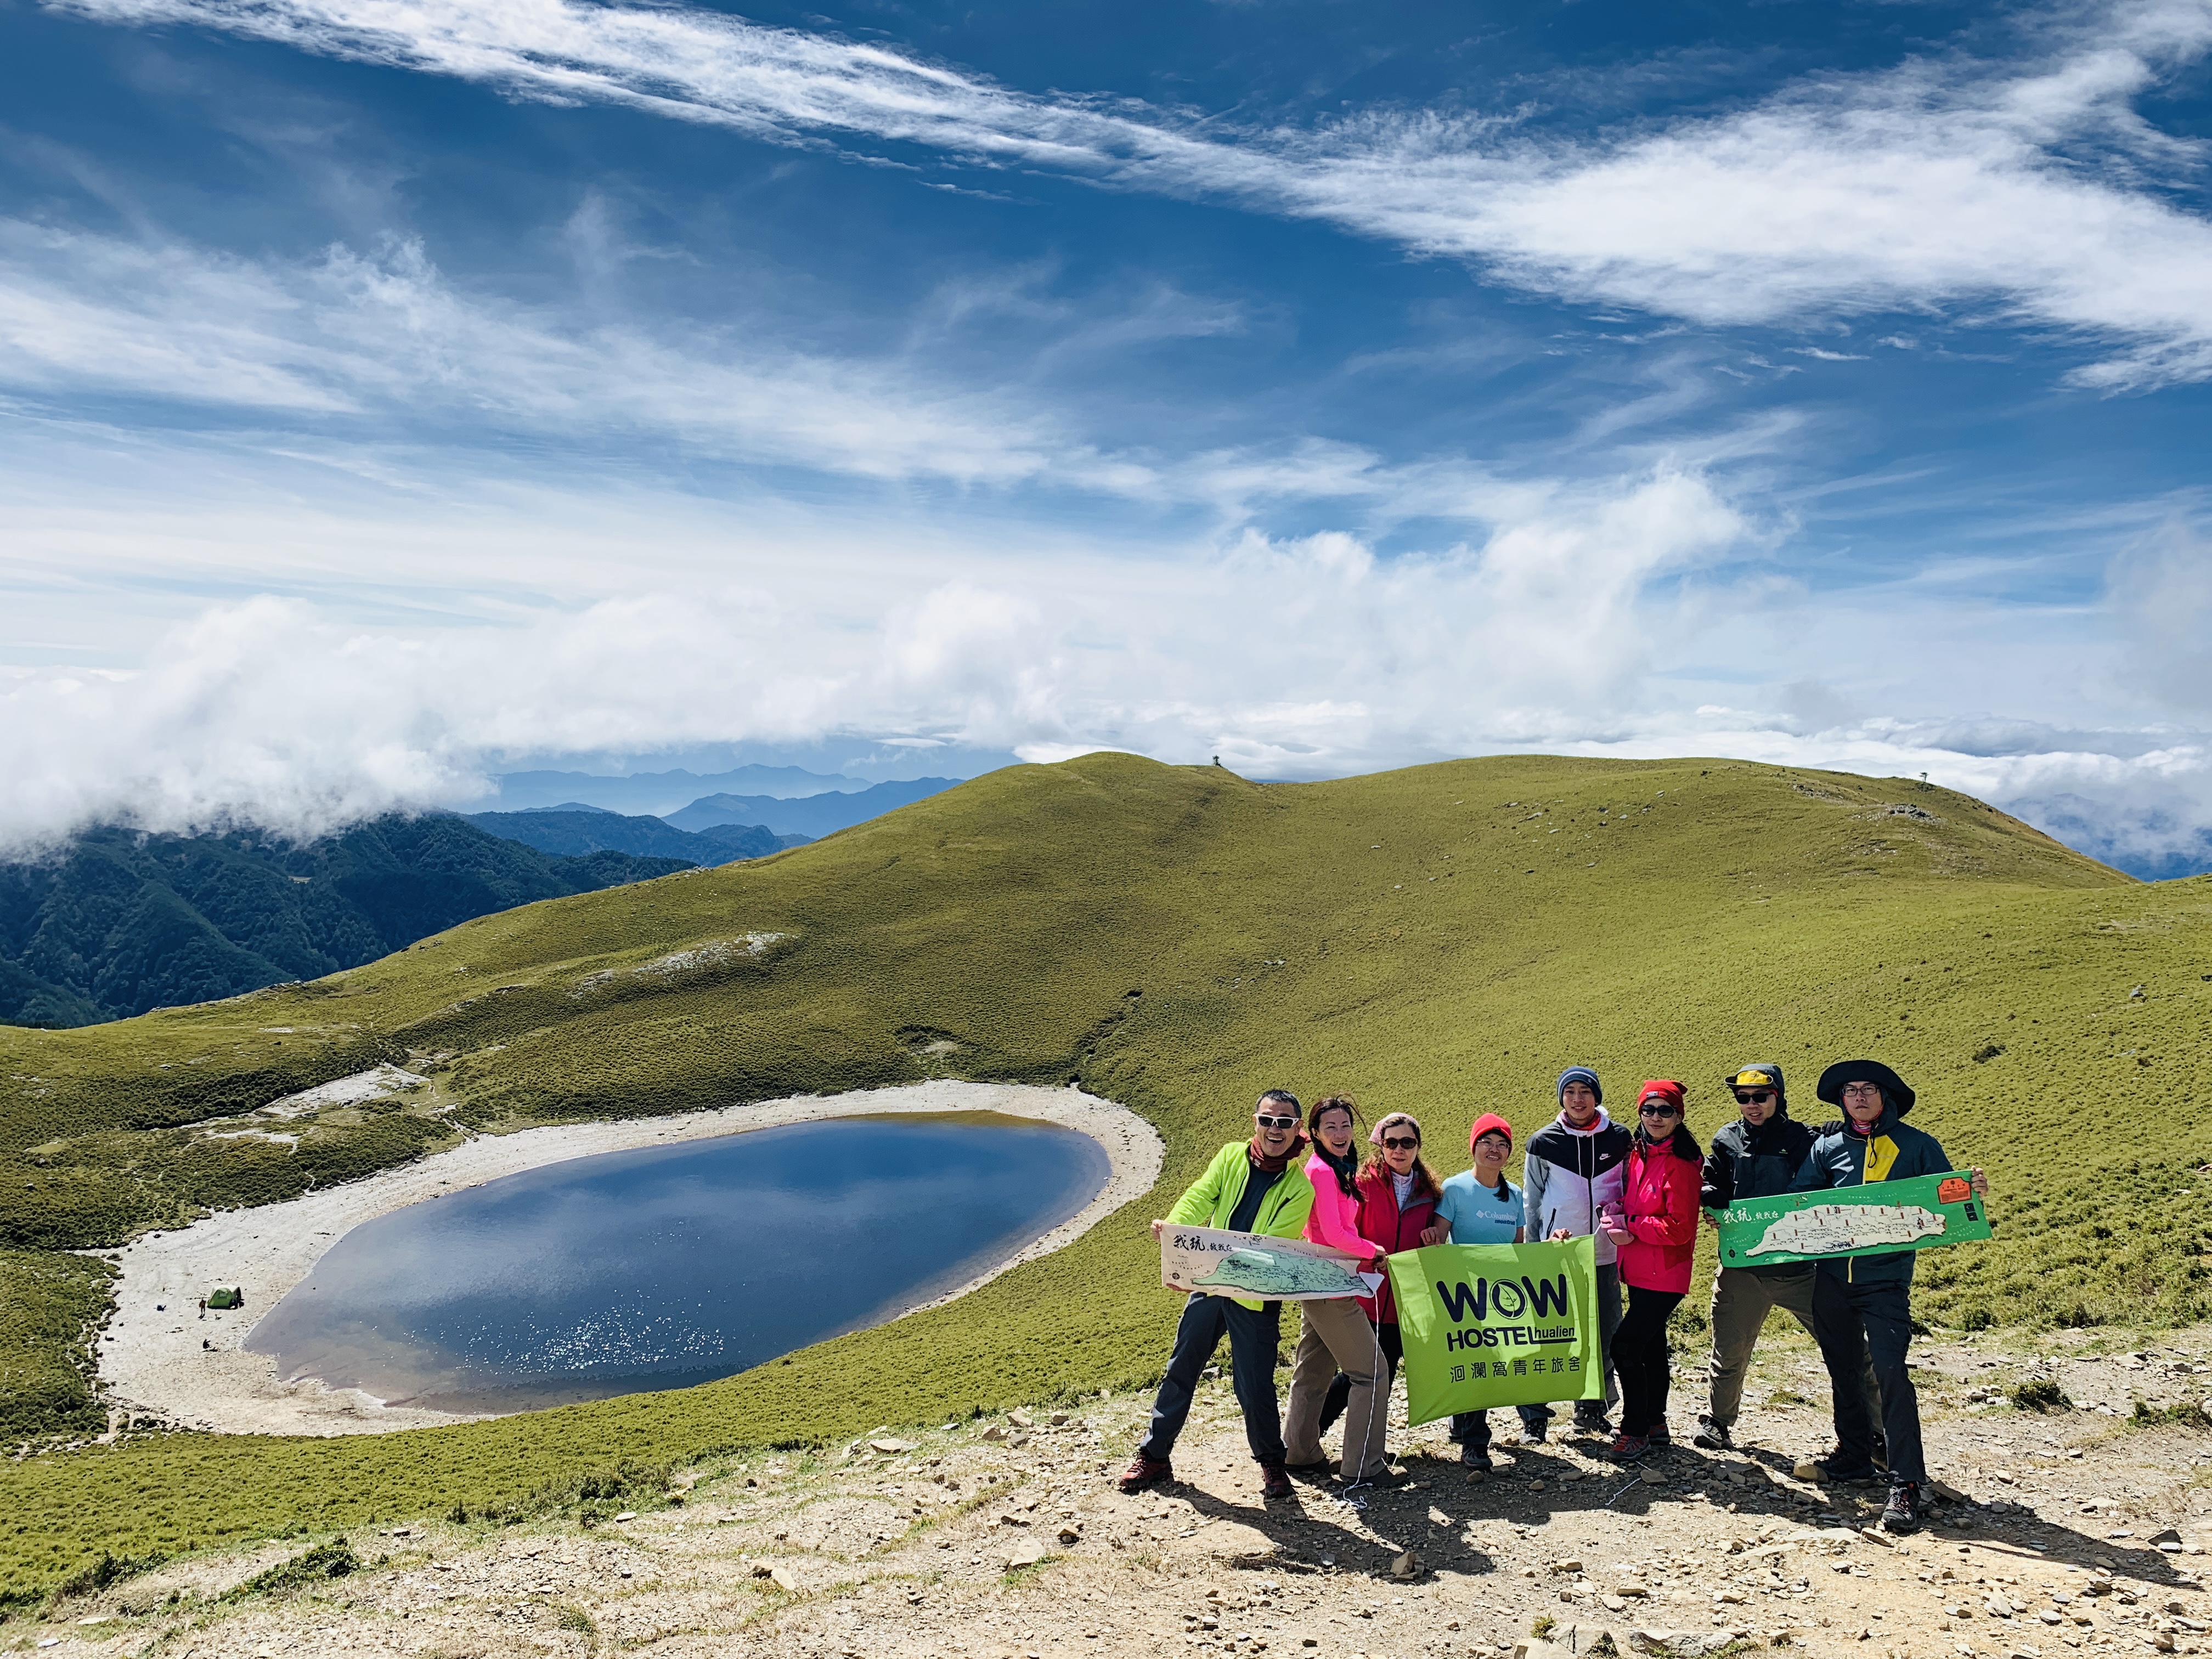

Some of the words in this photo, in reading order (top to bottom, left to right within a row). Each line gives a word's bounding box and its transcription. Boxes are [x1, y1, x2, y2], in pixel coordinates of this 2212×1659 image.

[1436, 1273, 1567, 1323] WOW
[1446, 1326, 1543, 1352] HOSTEL
[1534, 1325, 1575, 1339] hualien
[1449, 1356, 1581, 1383] 洄瀾窩青年旅舍
